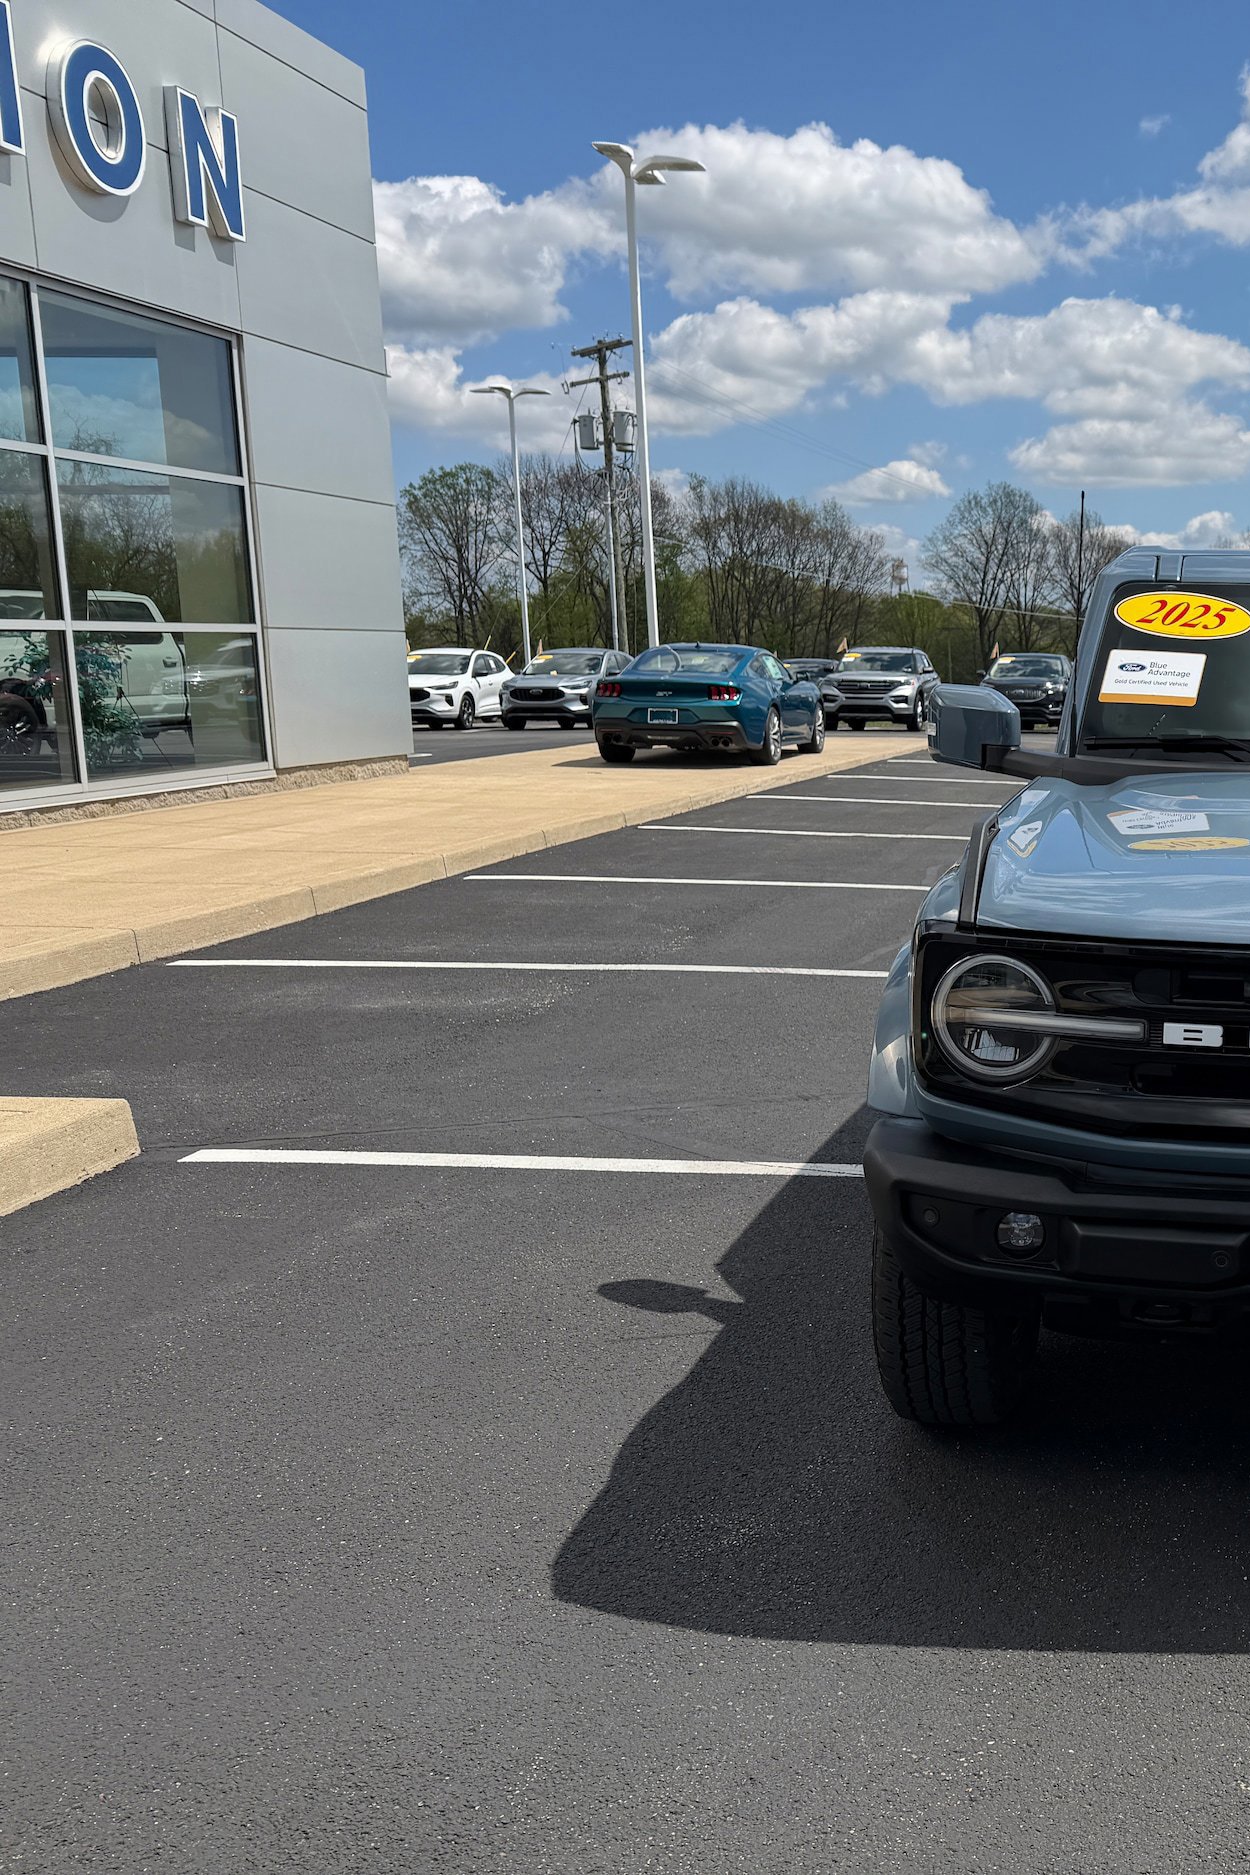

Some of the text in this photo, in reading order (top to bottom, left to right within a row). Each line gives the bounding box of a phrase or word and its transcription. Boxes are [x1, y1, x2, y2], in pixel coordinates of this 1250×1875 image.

[1135, 599, 1237, 630] 2025
[1121, 661, 1168, 672] Ford Blue
[1147, 669, 1191, 678] Advantage
